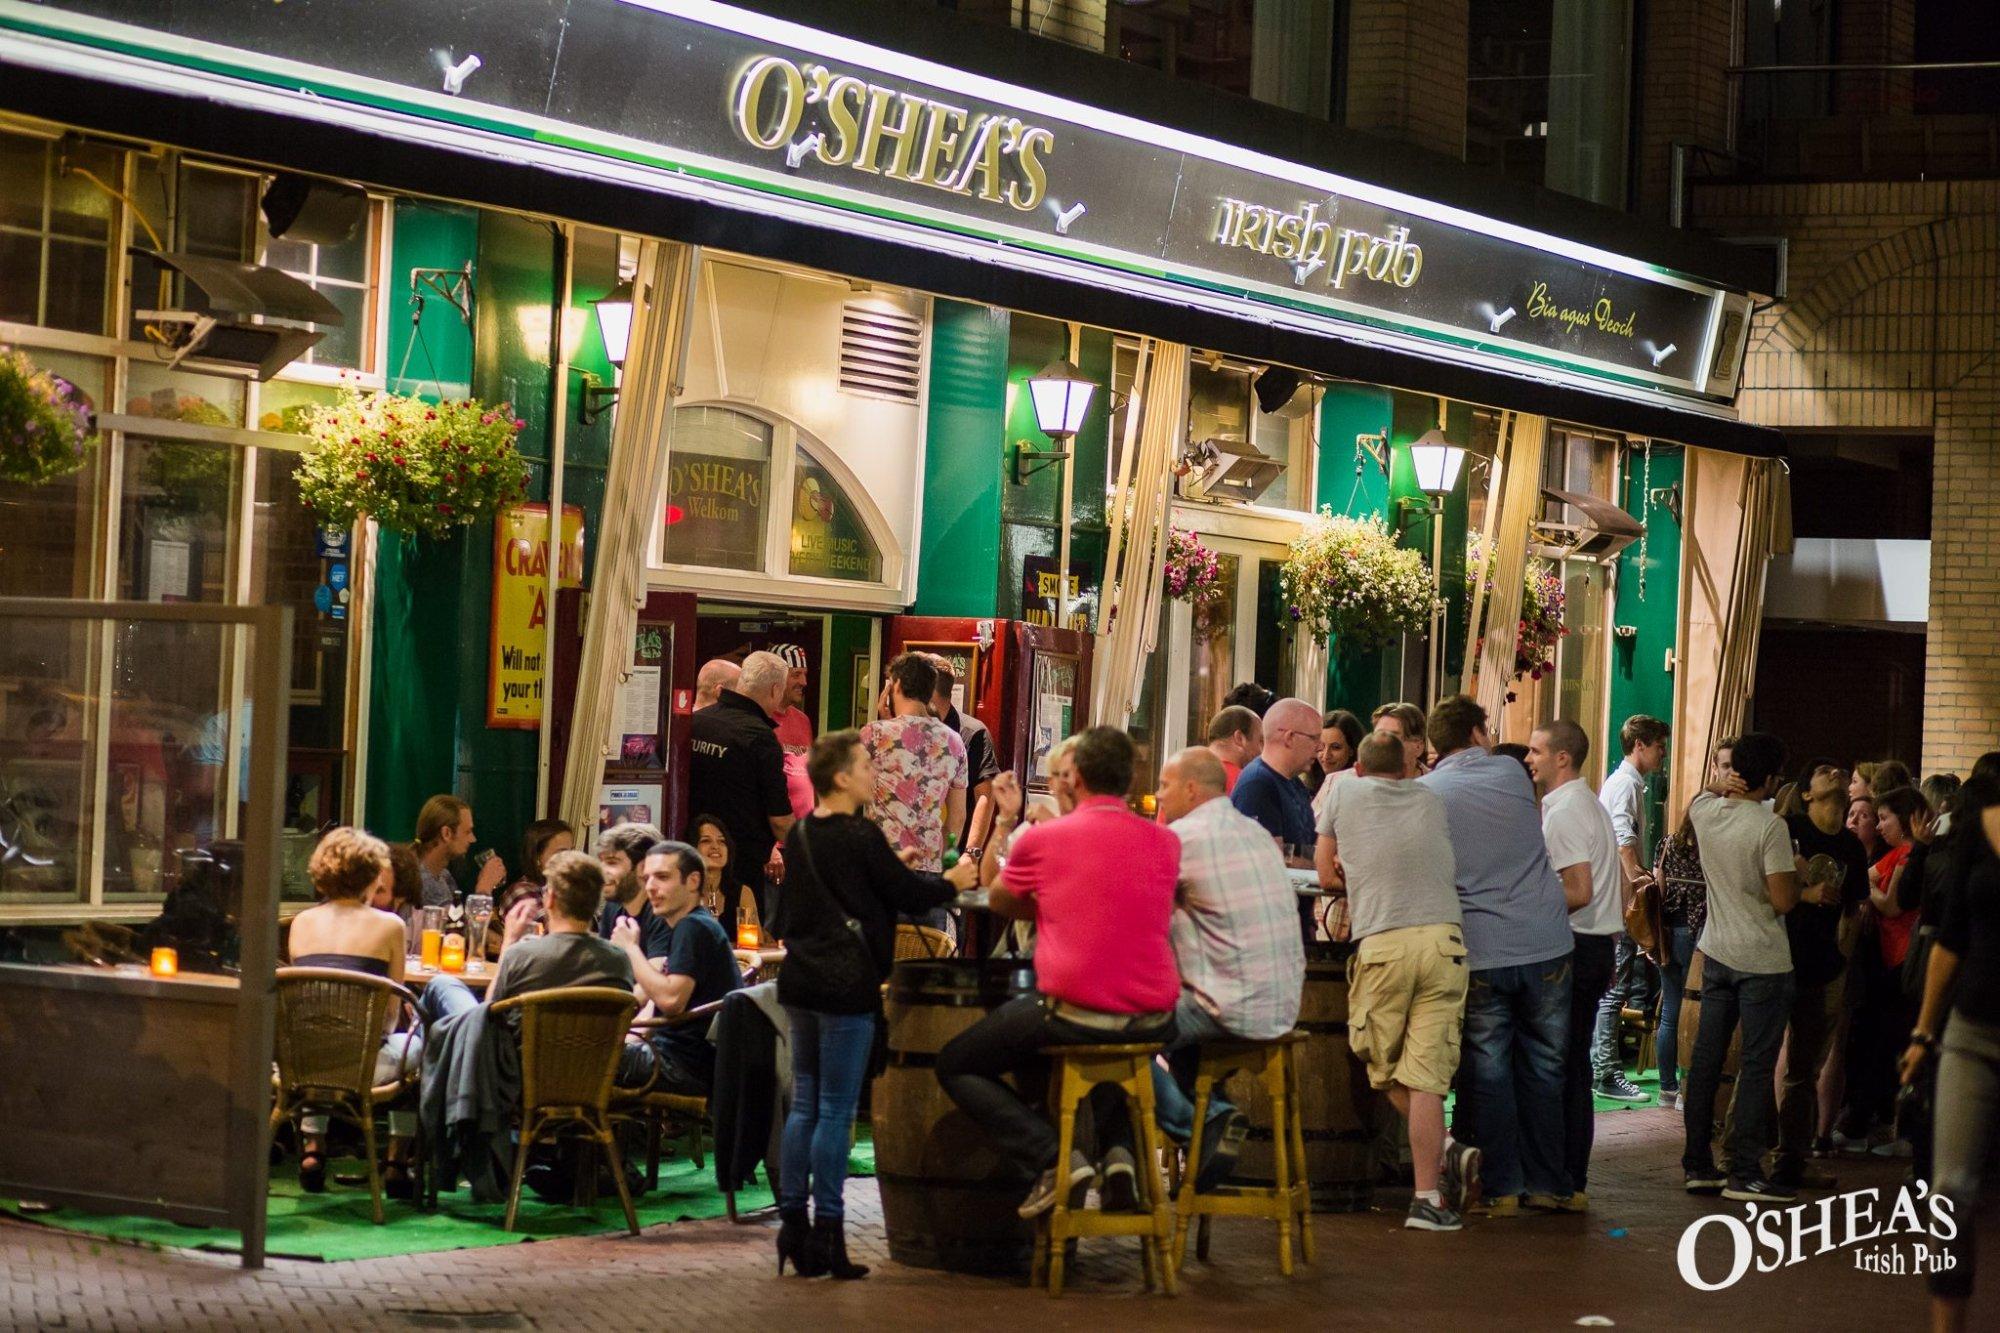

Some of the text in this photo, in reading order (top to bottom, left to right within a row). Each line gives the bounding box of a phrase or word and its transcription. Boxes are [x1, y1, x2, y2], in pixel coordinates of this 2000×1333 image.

[737, 56, 1054, 212] O'SHEA'S
[1526, 281, 1636, 338] Bia agus Deoch
[670, 462, 761, 507] O'SHEA'S
[687, 496, 739, 521] Welkom
[800, 533, 824, 550] LIVE
[1043, 577, 1075, 596] SMOE
[502, 645, 522, 671] Will
[524, 651, 541, 672] not
[503, 681, 530, 701] your
[691, 738, 728, 758] URITY
